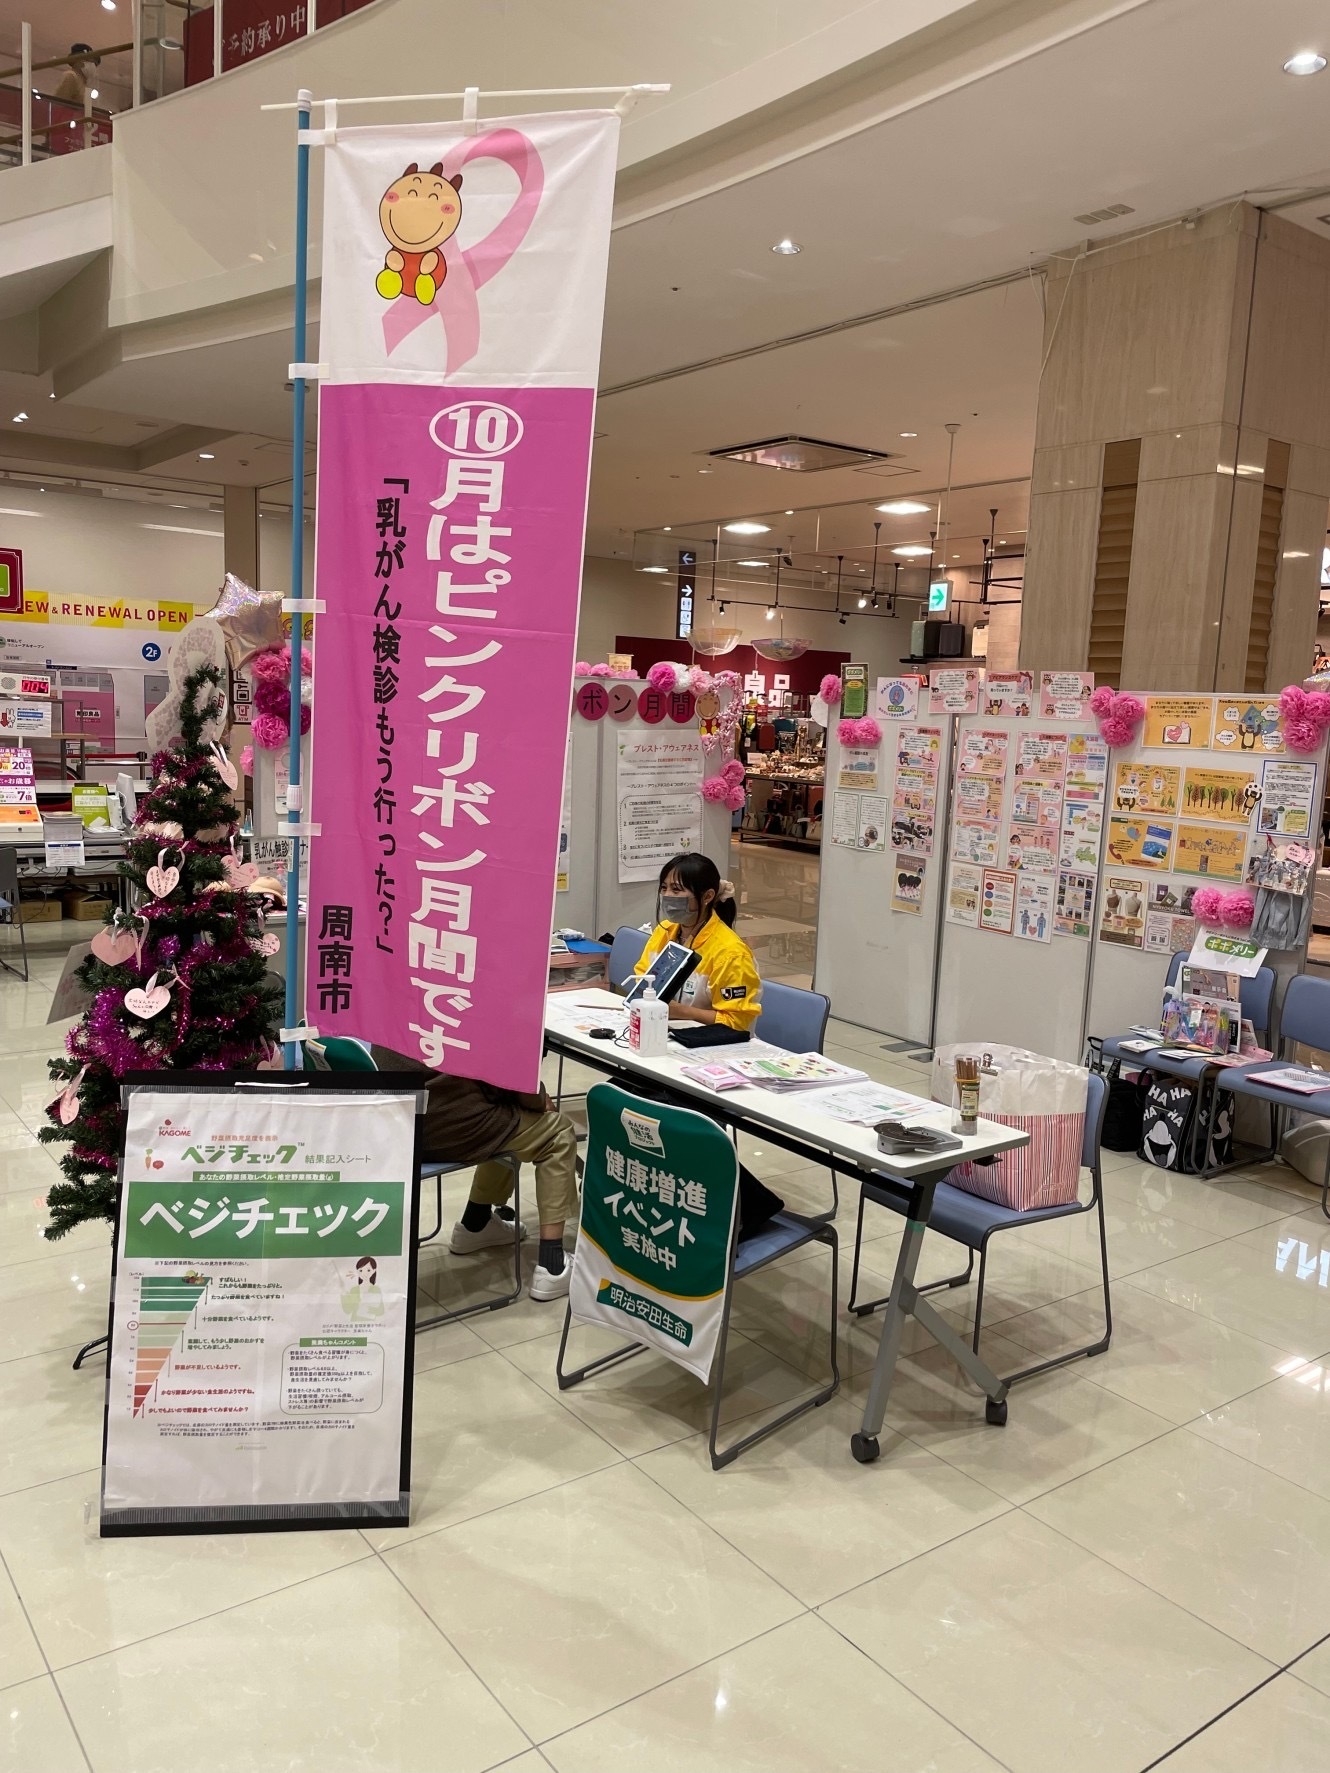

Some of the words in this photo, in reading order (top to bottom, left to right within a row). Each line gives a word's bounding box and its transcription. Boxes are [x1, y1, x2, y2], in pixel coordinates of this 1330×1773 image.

[24, 600, 49, 614] EW
[51, 606, 58, 614] &
[62, 603, 142, 621] RENEWAL
[147, 609, 188, 623] OPEN
[145, 646, 158, 658] 2F
[22, 680, 49, 693] 004
[633, 743, 699, 753] ブレスト・アウェアネス
[1208, 938, 1255, 955] ポポメリー
[317, 905, 353, 1014] 周南市
[1148, 1084, 1168, 1107] HA
[1169, 1086, 1192, 1101] HA
[1143, 1105, 1158, 1121] HA
[1167, 1108, 1184, 1128] HA
[158, 1129, 191, 1137] KAGOME
[181, 1145, 298, 1165] ベジチェック
[304, 1153, 372, 1164] 結果記入シート
[605, 1145, 708, 1217] 健康増進
[139, 1196, 391, 1240] ベジチェック
[603, 1190, 697, 1248] イベント
[620, 1225, 677, 1272] 実施中
[610, 1286, 688, 1341] 明治安田生命
